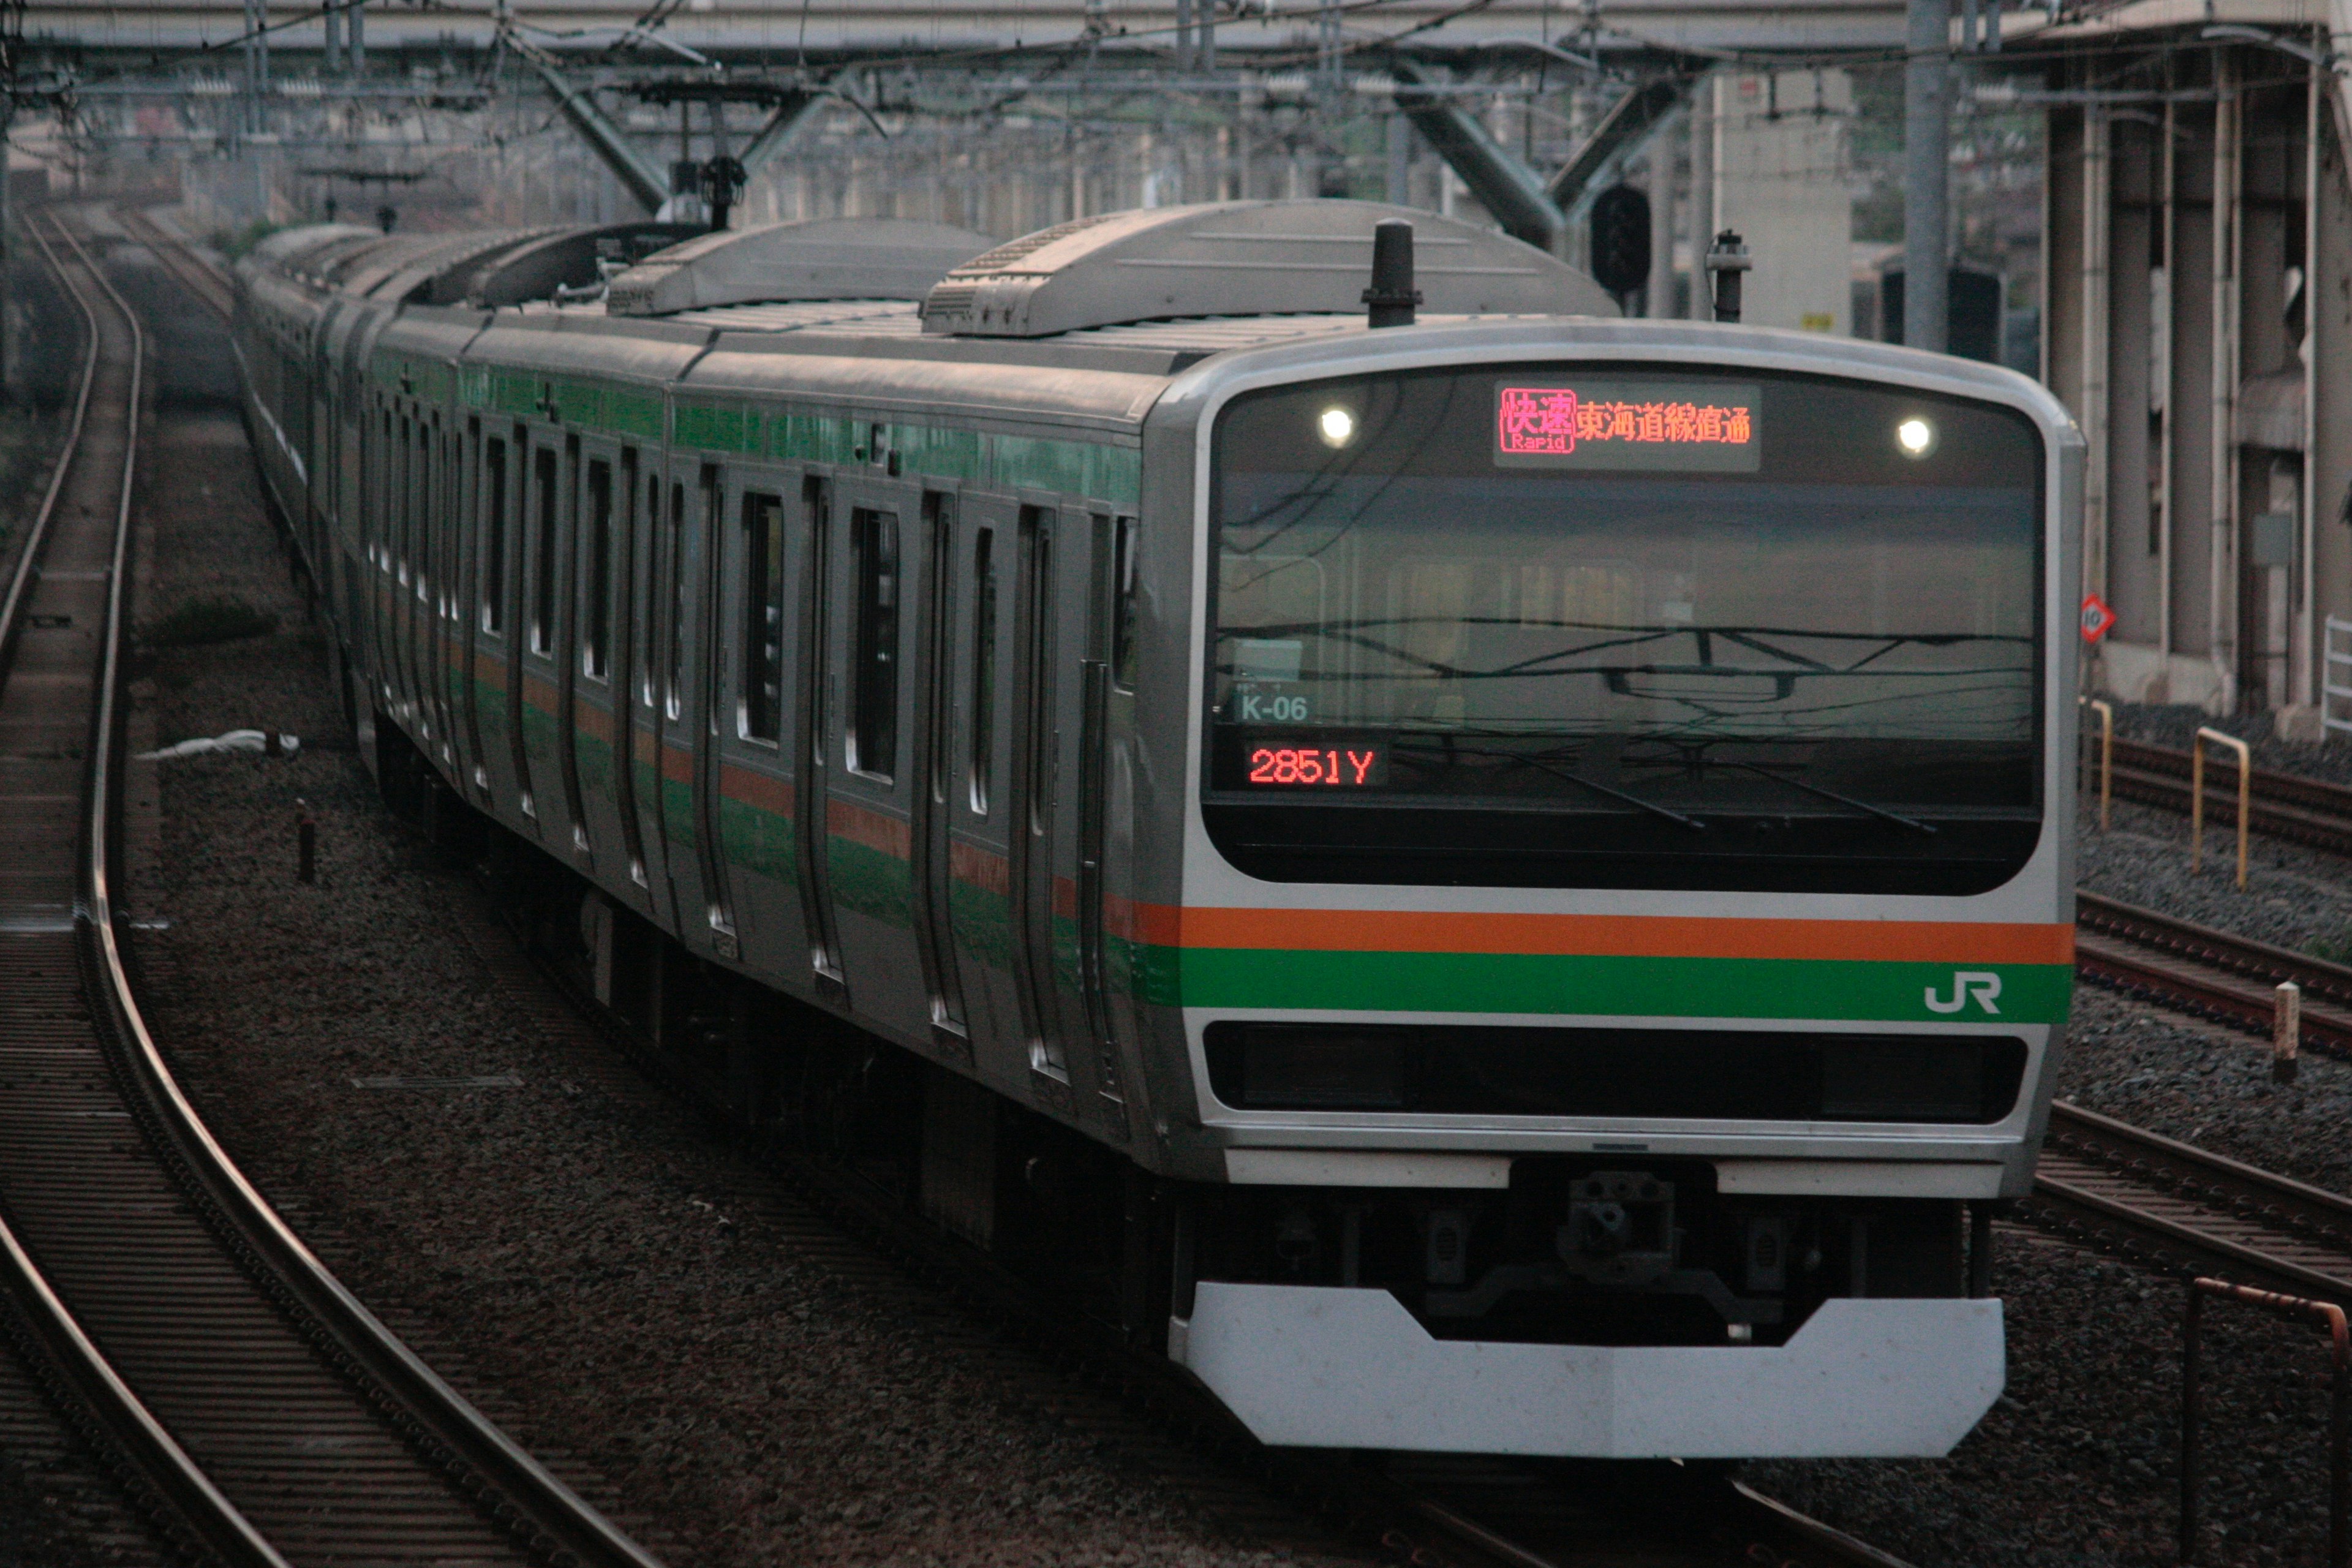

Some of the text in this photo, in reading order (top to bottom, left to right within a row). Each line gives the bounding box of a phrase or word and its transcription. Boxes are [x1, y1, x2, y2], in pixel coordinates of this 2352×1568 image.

[1507, 392, 1751, 443] 快速 東海道線直通
[1512, 435, 1566, 450] Rapid
[1242, 696, 1308, 721] K-06
[1250, 748, 1374, 785] 2851Y
[1924, 971, 2002, 1014] JR
